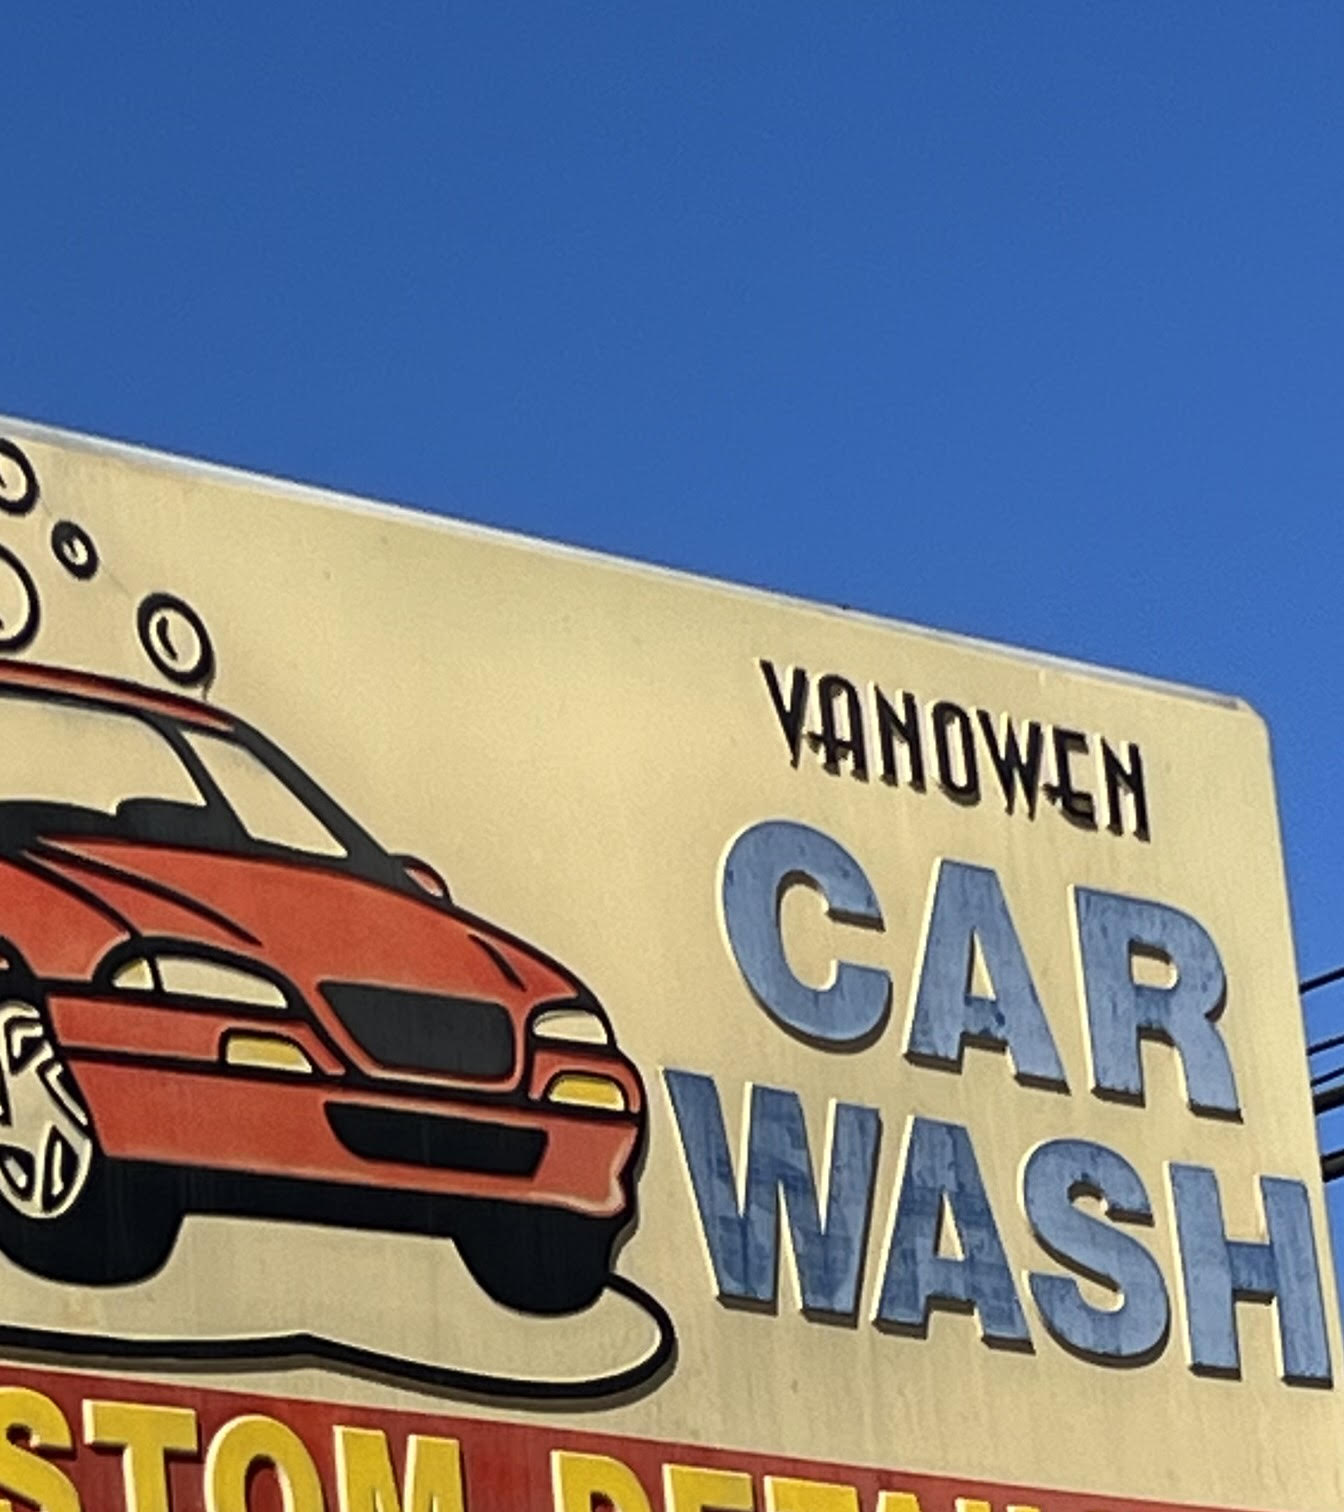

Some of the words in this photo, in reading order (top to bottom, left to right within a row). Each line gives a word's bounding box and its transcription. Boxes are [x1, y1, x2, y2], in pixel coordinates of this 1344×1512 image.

[756, 657, 1152, 843] VANOWEN
[716, 819, 1244, 1123] CAR
[659, 1066, 1334, 1390] WASH
